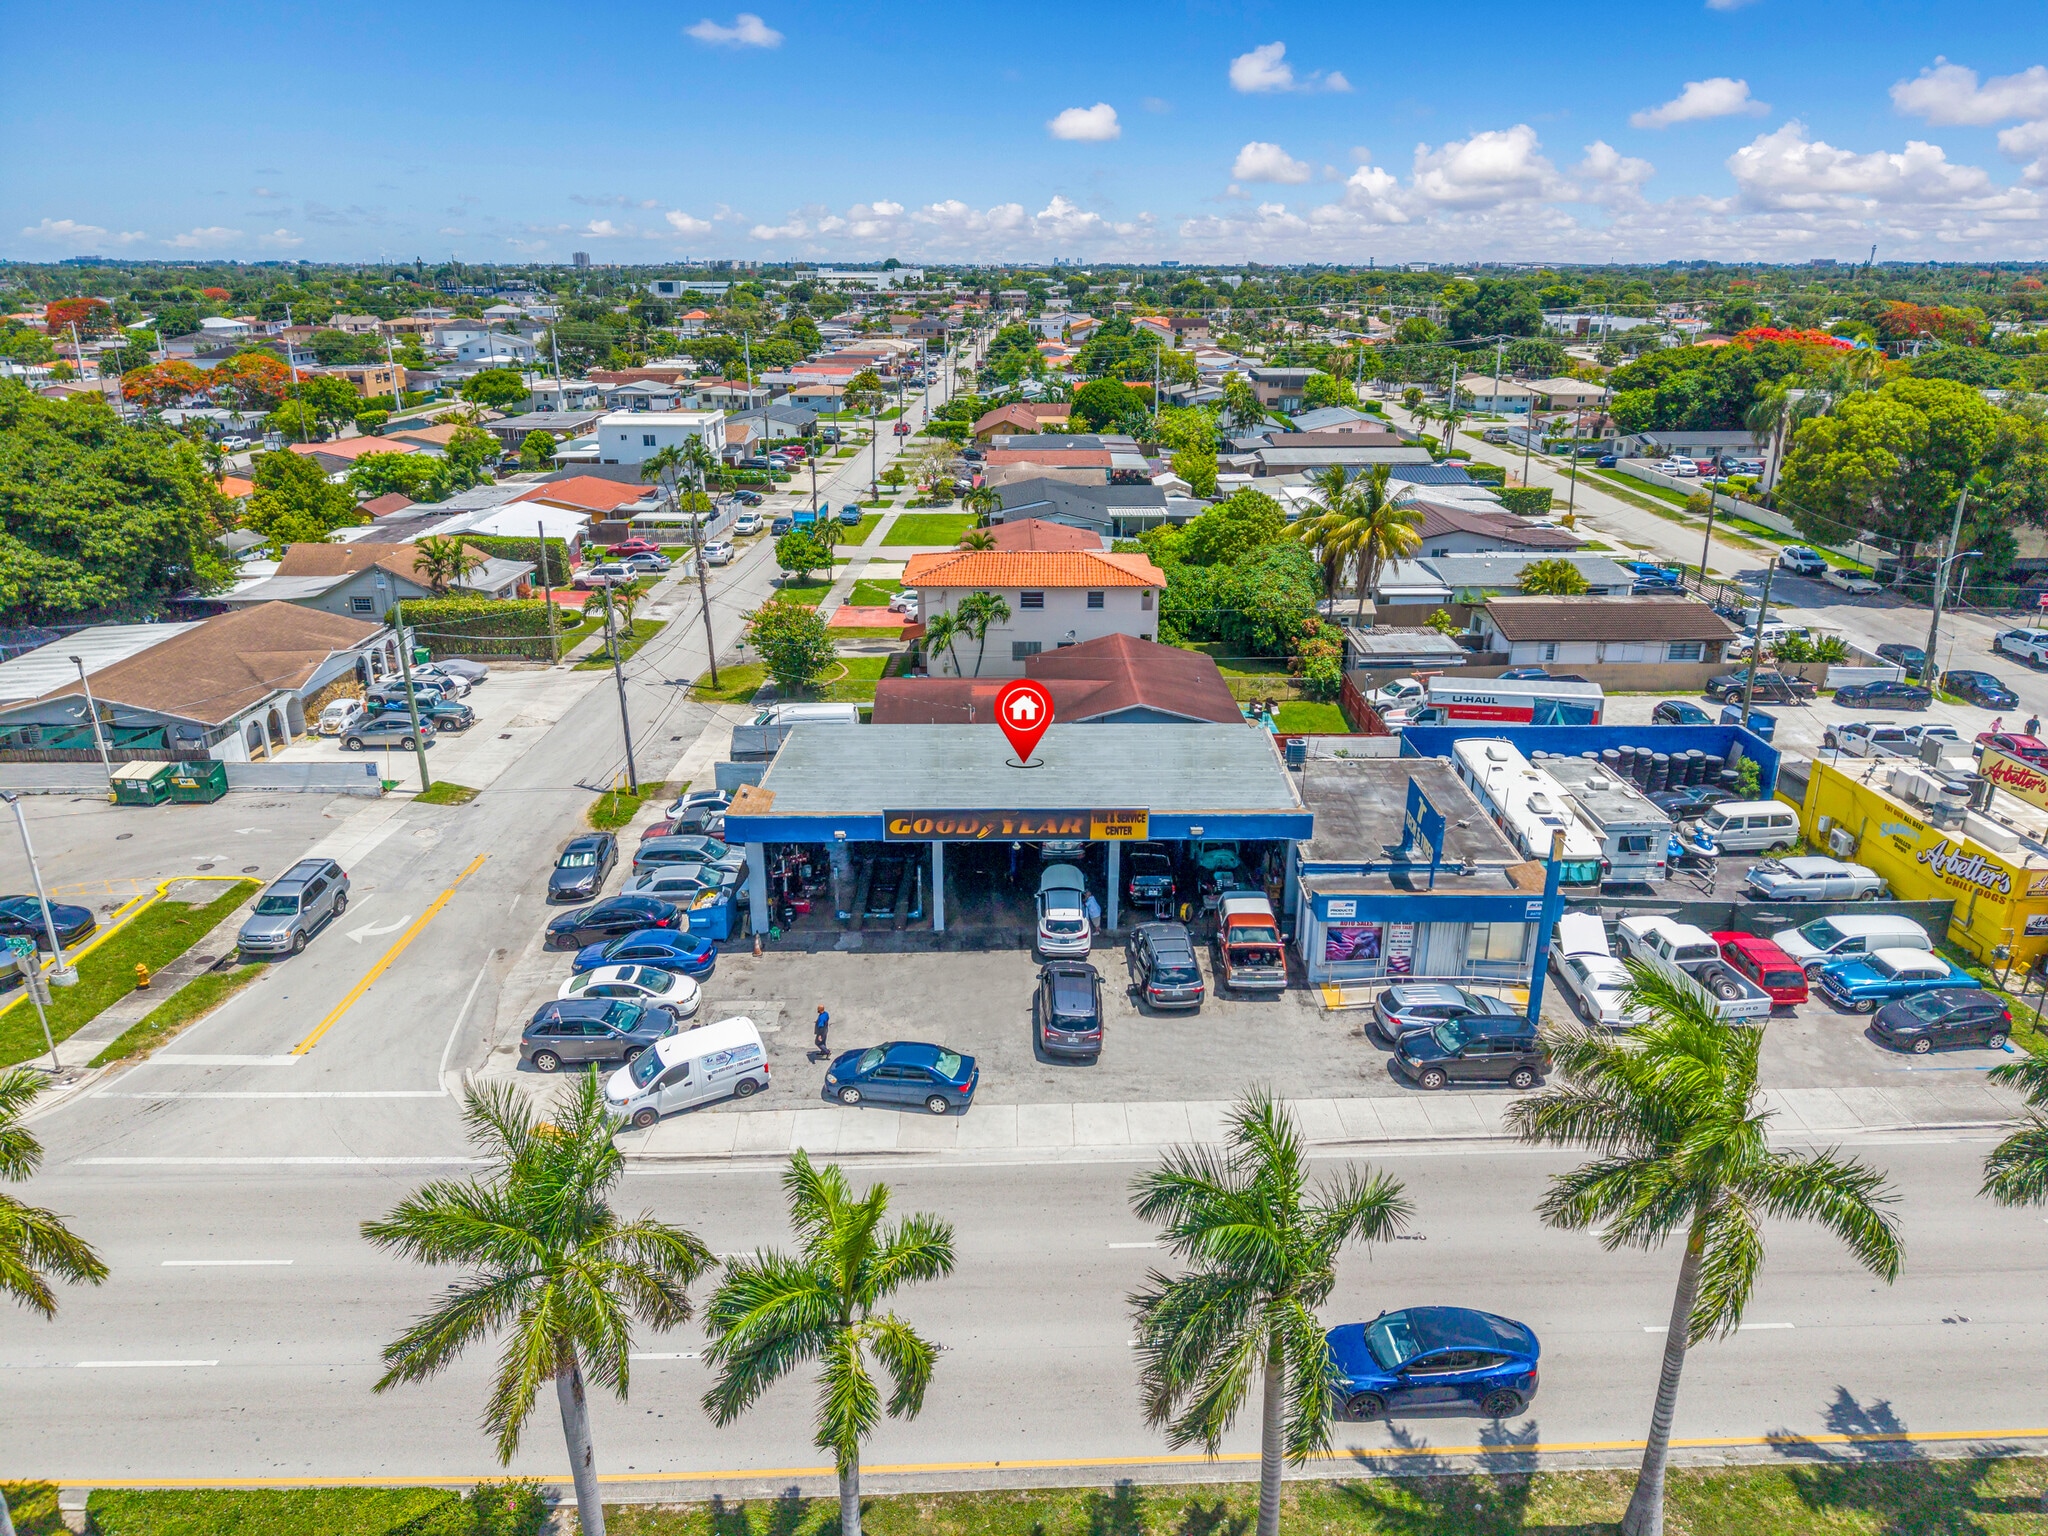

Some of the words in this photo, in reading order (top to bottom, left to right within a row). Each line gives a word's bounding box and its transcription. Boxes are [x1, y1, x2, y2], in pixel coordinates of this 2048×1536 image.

[1452, 695, 1498, 704] U-HAUL
[1982, 760, 2047, 794] Arbetter's
[889, 817, 1084, 840] GOODYEAR
[1093, 813, 1108, 824] TIRE
[1110, 814, 1115, 824] &
[1117, 813, 1146, 824] SERVICE
[1903, 815, 1912, 825] ALL
[1911, 820, 1925, 832] BEEF
[1105, 825, 1133, 836] CENTER
[1916, 838, 2012, 895] Arbetter's
[1944, 876, 1974, 893] CHILI
[1976, 888, 2007, 905] DOGS
